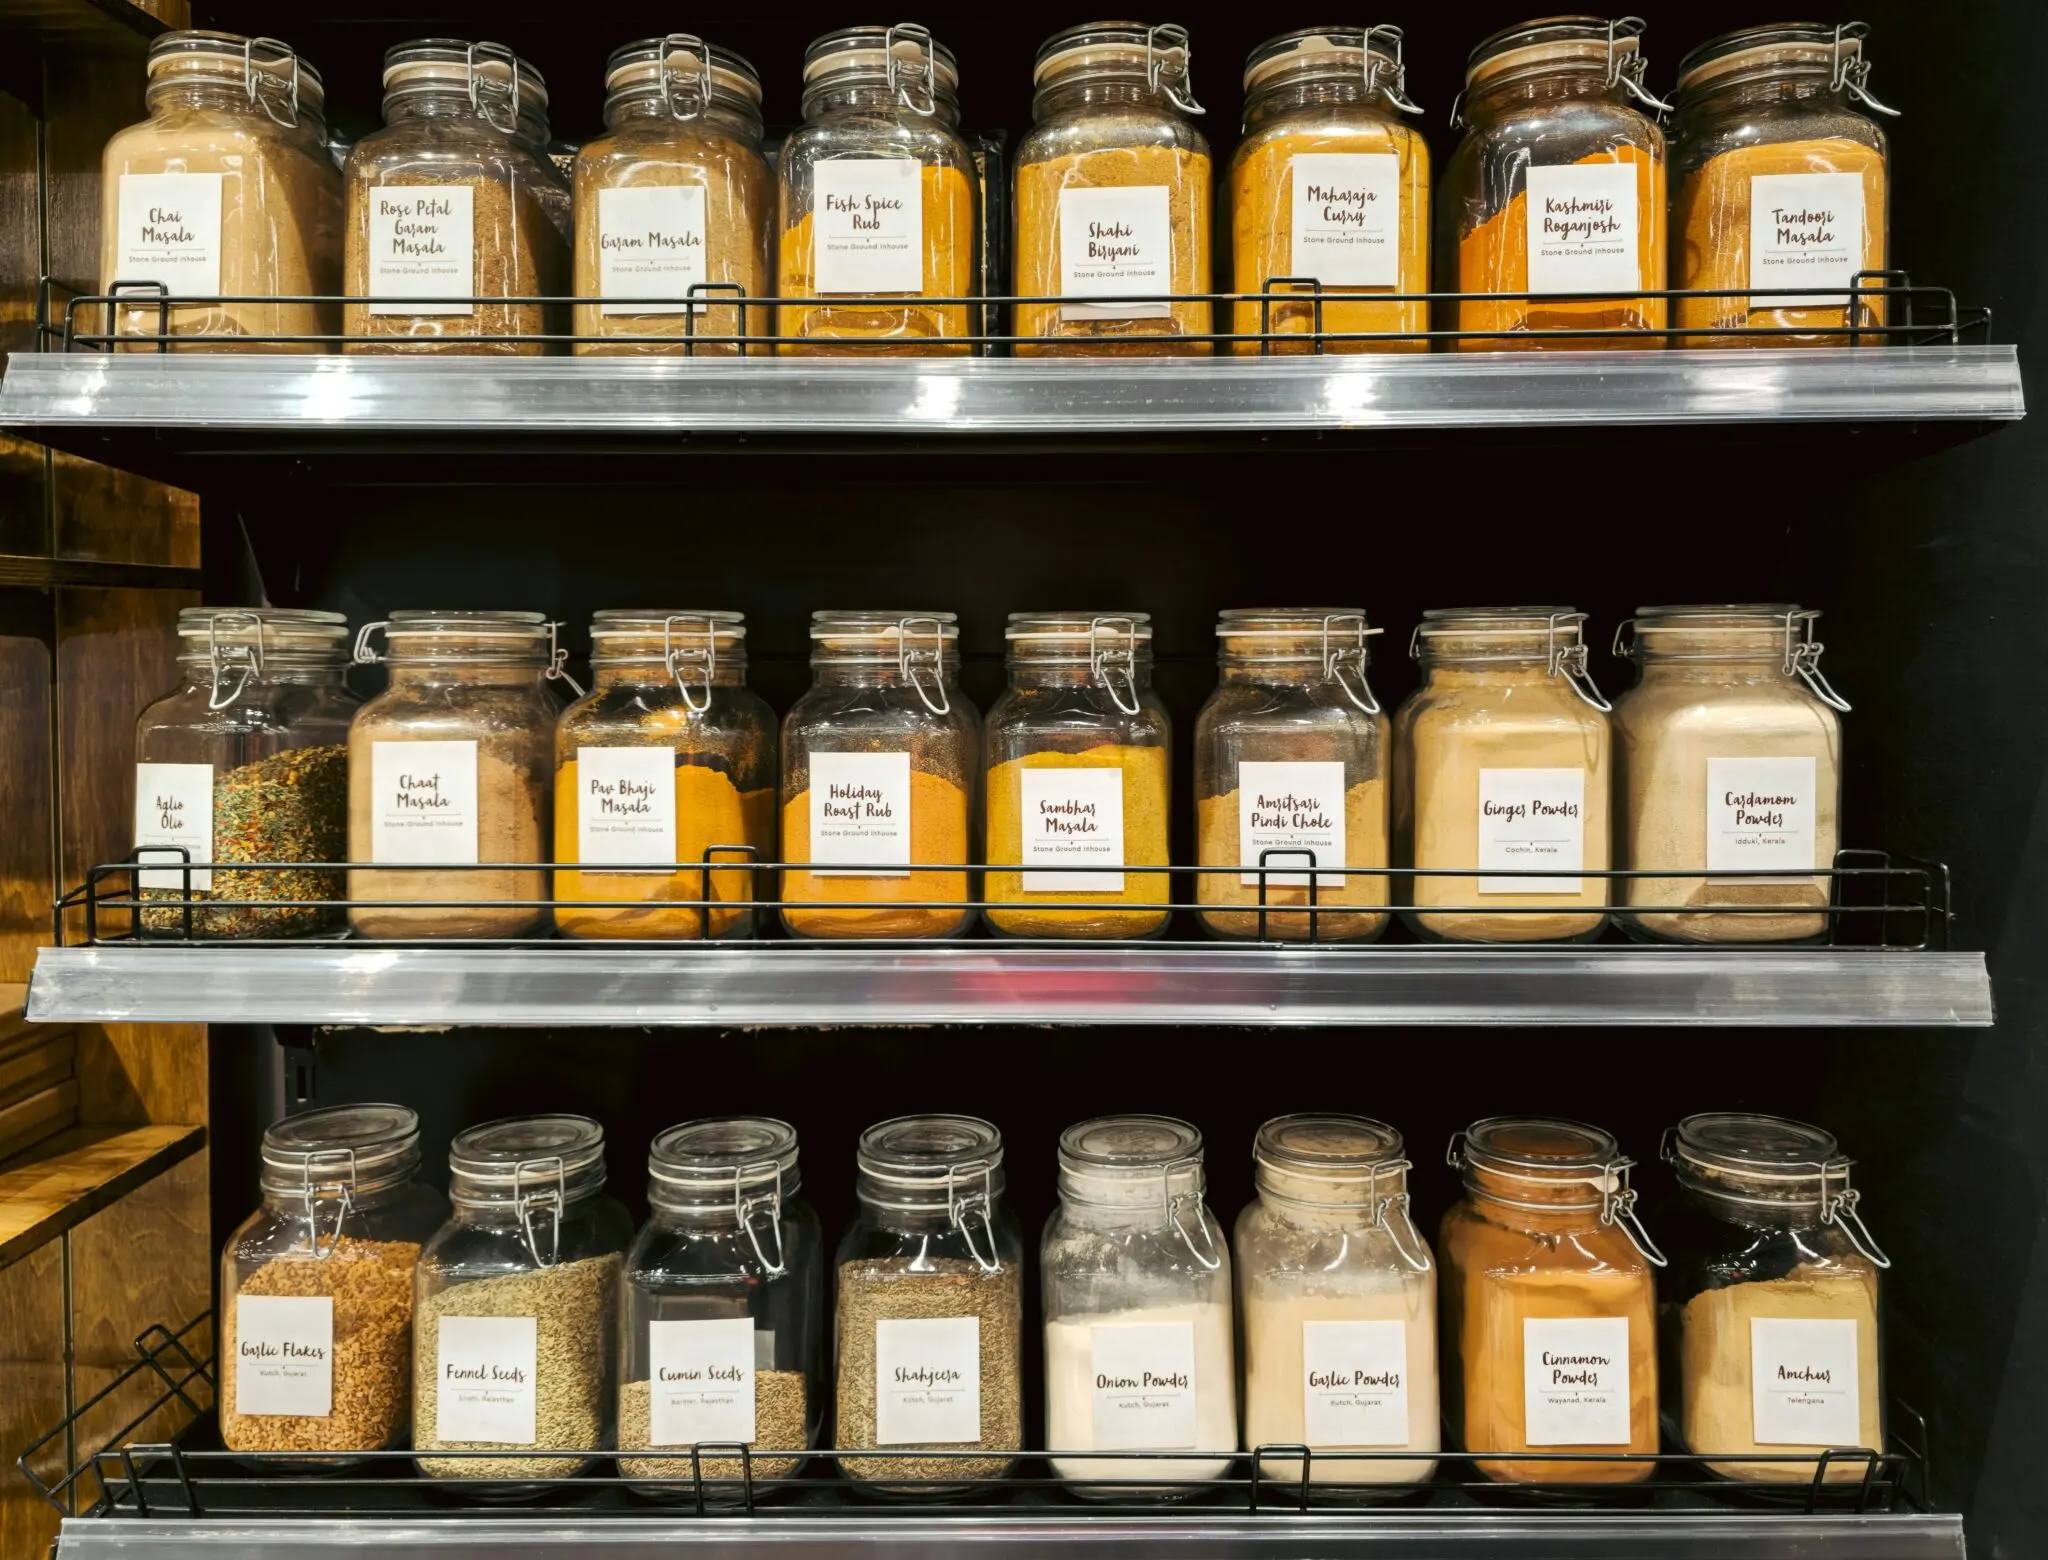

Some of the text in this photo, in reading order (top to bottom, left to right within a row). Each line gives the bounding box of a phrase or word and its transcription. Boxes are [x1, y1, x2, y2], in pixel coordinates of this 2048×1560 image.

[1308, 186, 1377, 207] Maharaja
[381, 199, 451, 217] Rose Petal
[827, 194, 902, 218] Fish Spice
[1546, 197, 1612, 217] Kashmiri
[149, 208, 182, 224] Chai
[853, 213, 880, 230] Rub
[1324, 205, 1365, 227] Curry
[1771, 209, 1834, 228] Tandoori
[142, 226, 194, 245] Masala
[395, 219, 438, 238] Garam
[1089, 222, 1132, 239] Shahi
[1544, 216, 1621, 240] Roganjosh
[1777, 227, 1834, 245] Masala
[393, 238, 445, 256] Masala
[601, 231, 701, 251] Garam Masala
[1089, 242, 1139, 262] Biryani
[400, 773, 440, 791] Chaat
[591, 780, 656, 799] Pav Bhaji
[397, 792, 449, 810] Masala
[830, 784, 882, 803] Holiday
[1725, 792, 1796, 808] Cardamom
[157, 796, 184, 816] Aglio
[602, 796, 651, 815] Masala
[824, 801, 891, 819] Roast Rub
[1040, 800, 1095, 818] Sambhar
[1256, 795, 1321, 813] Amritsari
[1484, 800, 1577, 822] Ginger Powder
[161, 813, 183, 829] Olio
[1046, 816, 1097, 834] Masala
[1252, 810, 1332, 829] Pindi Chole
[1736, 810, 1782, 827] Powder
[241, 1342, 326, 1360] Garlic Flakes
[1543, 1352, 1610, 1365] Cinnamon
[447, 1364, 527, 1383] Fennel Seeds
[659, 1365, 743, 1381] Cumin Seeds
[895, 1367, 960, 1387] Shahjeera
[1097, 1372, 1188, 1389] Onion Powder
[1309, 1371, 1399, 1389] Garlic Powder
[1553, 1370, 1597, 1387] Powder
[1778, 1365, 1830, 1383] Amchur
